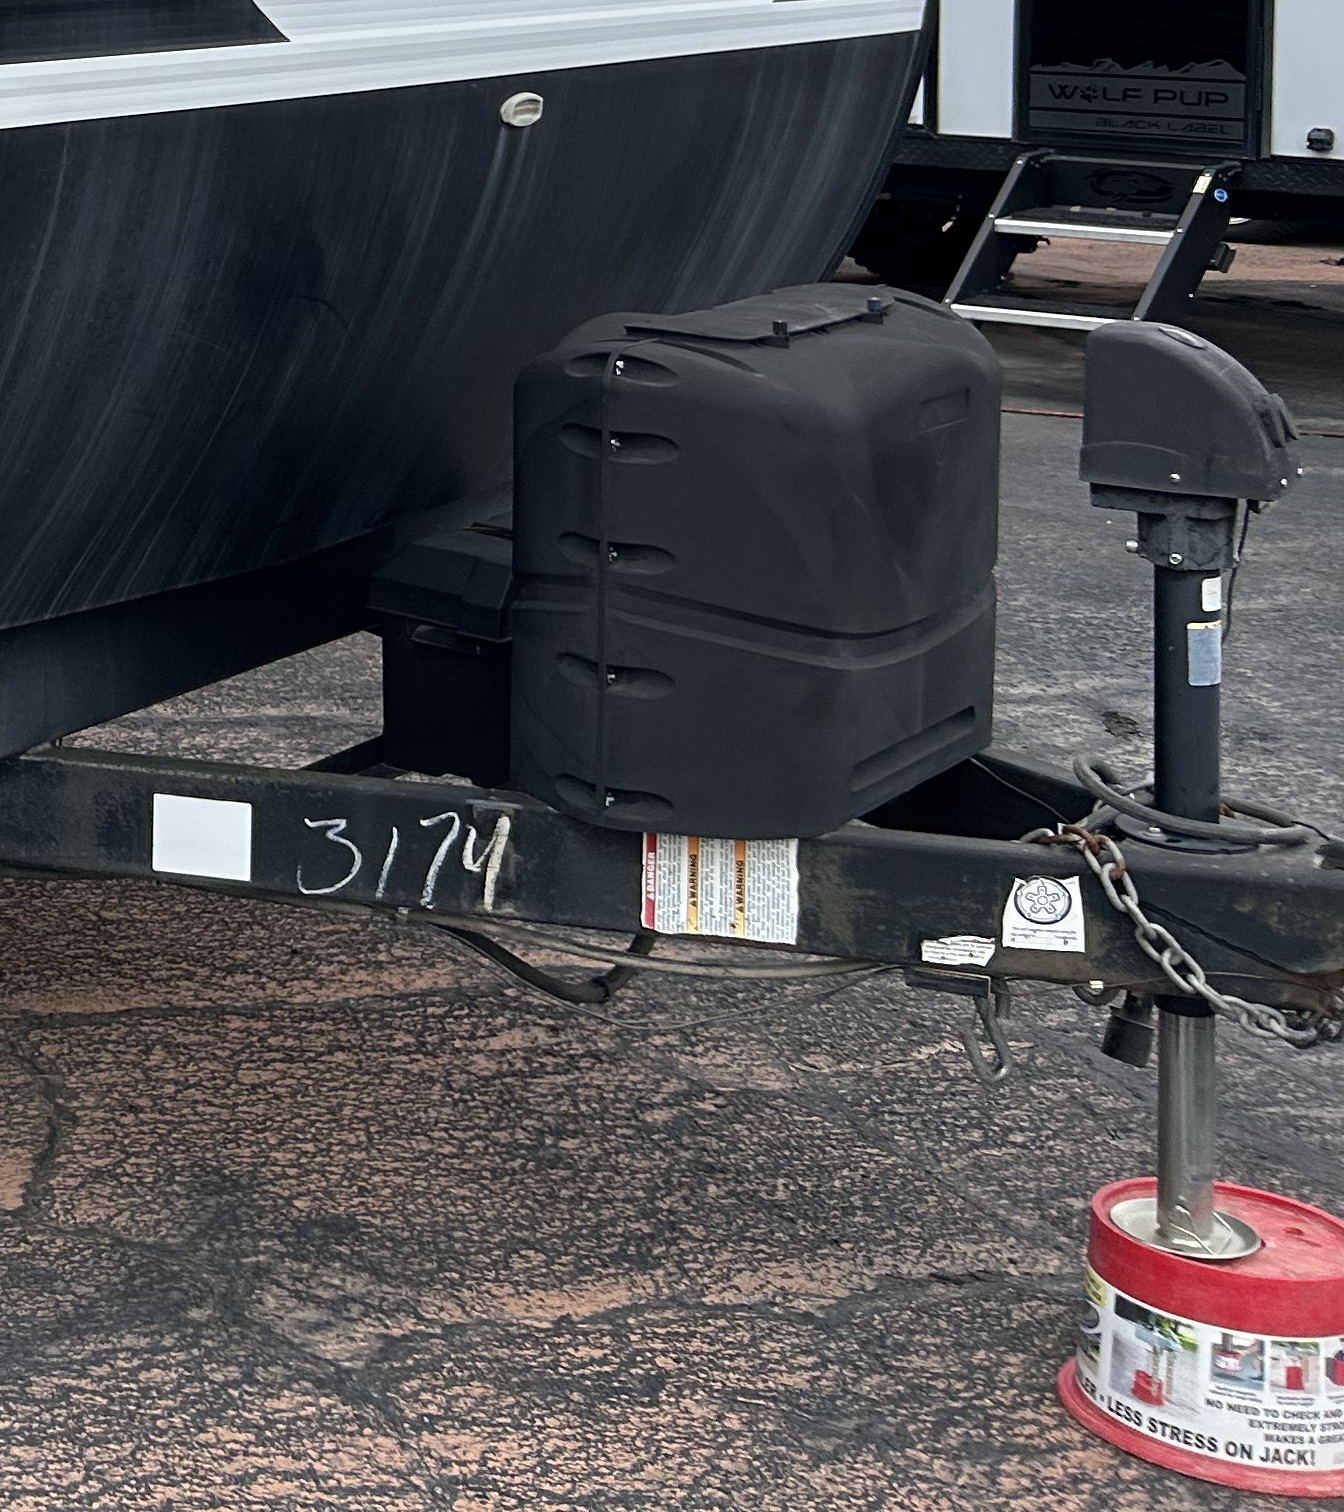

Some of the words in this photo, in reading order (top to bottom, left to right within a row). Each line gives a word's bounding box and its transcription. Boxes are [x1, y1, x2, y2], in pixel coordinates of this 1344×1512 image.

[1153, 88, 1229, 107] PUP
[1096, 117, 1160, 131] BLACK
[1167, 121, 1234, 135] LABEL
[296, 812, 511, 913] 3174
[646, 851, 656, 892] DANGER
[688, 854, 698, 899] WARNING
[736, 859, 746, 905] WARNING
[1107, 1395, 1143, 1427] LESS
[1147, 1418, 1219, 1453] STRESS
[1225, 1441, 1253, 1460] ON
[1259, 1446, 1315, 1466] JACK!
